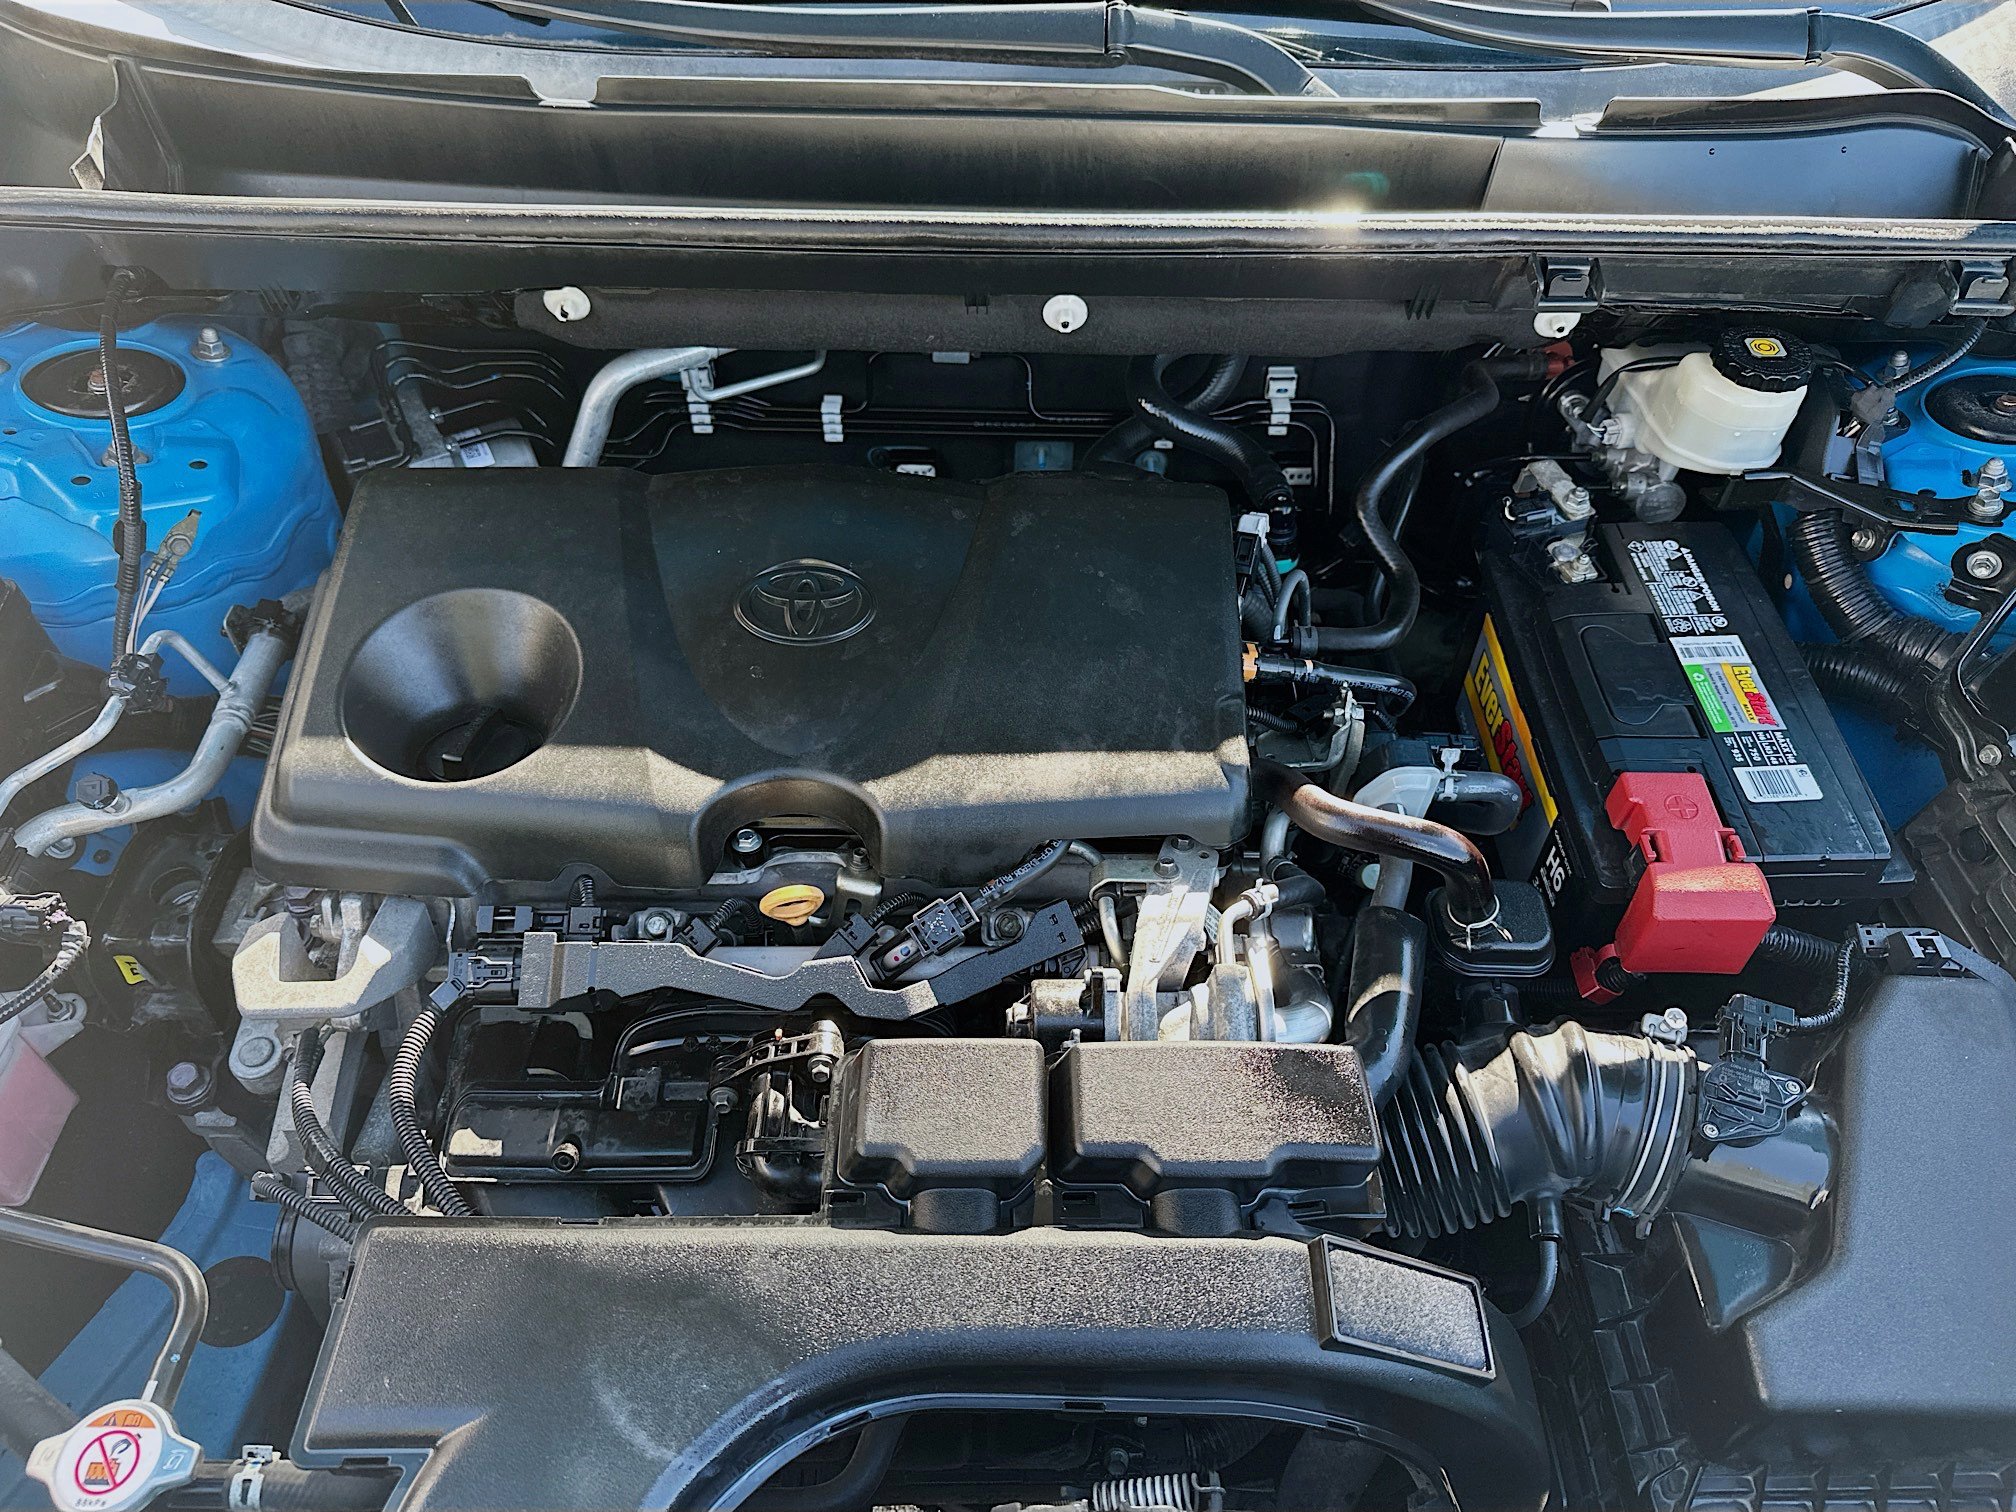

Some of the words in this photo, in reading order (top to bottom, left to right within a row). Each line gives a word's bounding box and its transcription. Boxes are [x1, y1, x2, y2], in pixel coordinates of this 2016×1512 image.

[1732, 665, 1777, 726] EverStart
[1743, 703, 1755, 721] MAXX
[1773, 731, 1791, 753] MAXX
[1546, 845, 1566, 892] H6
